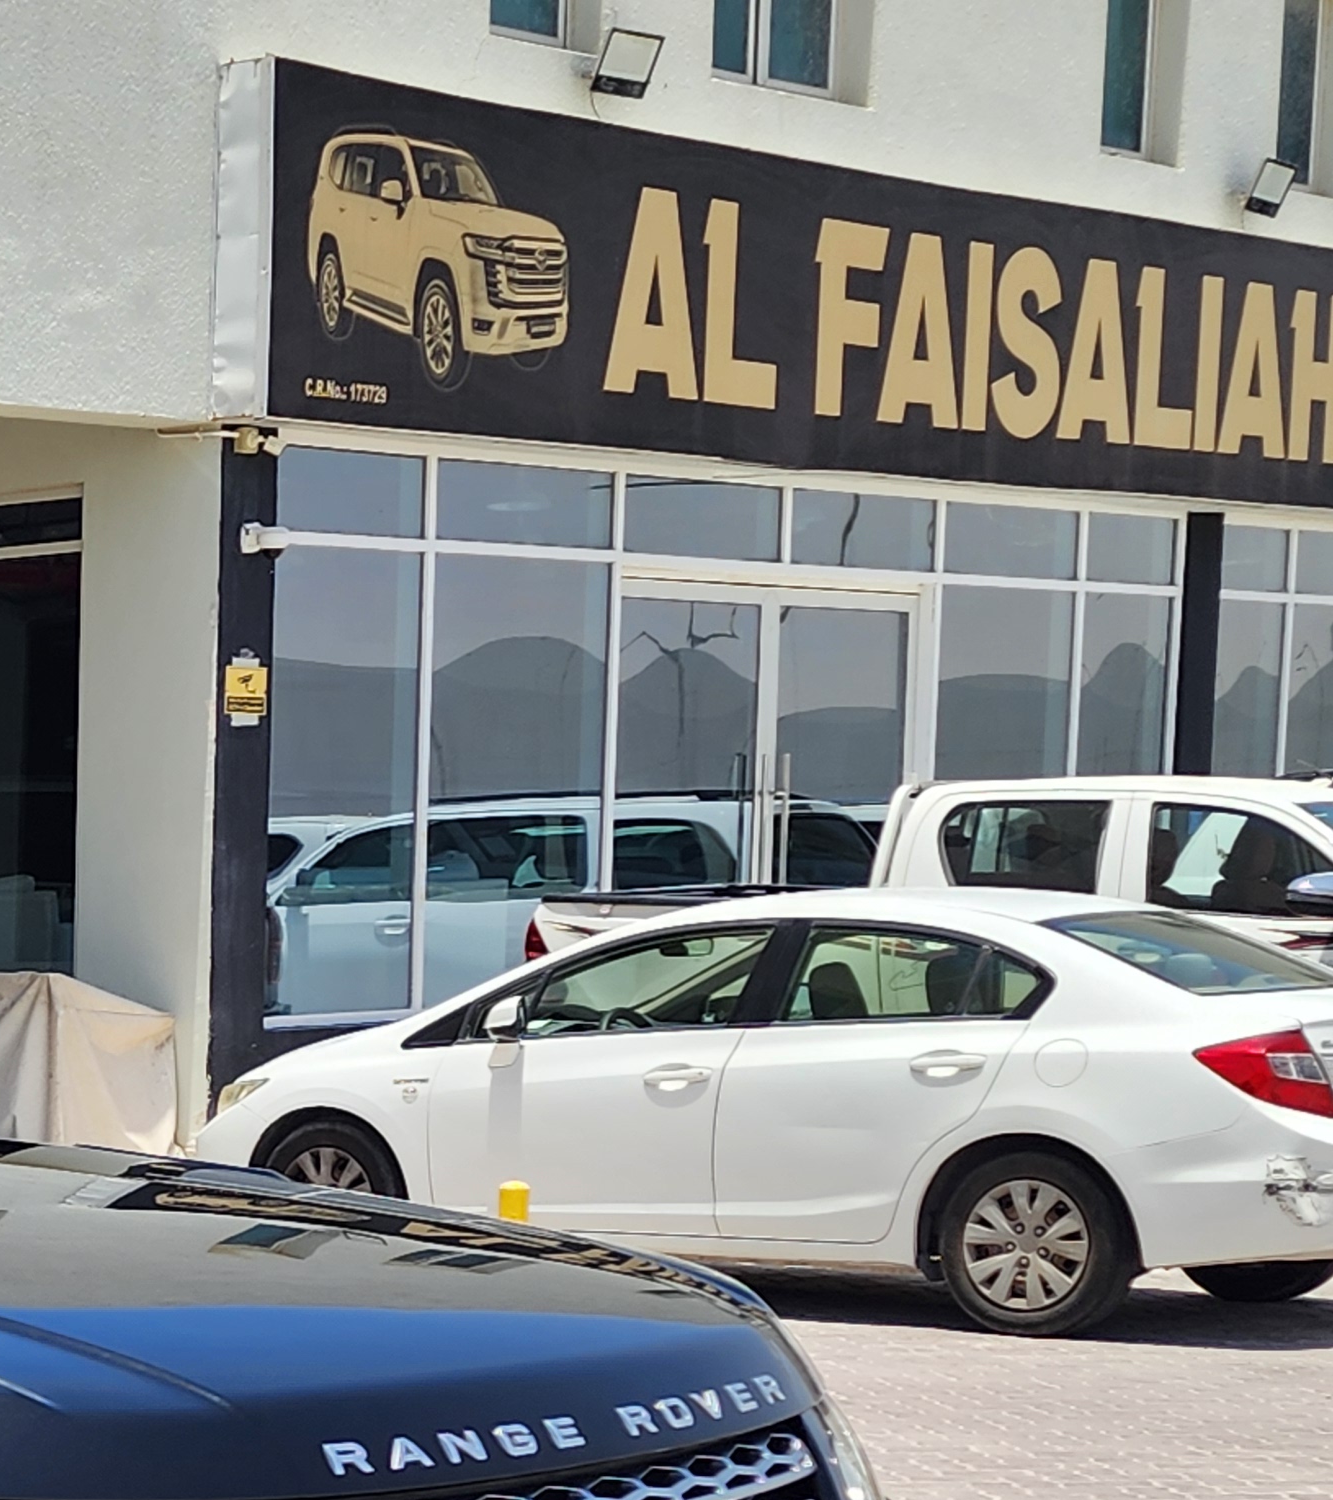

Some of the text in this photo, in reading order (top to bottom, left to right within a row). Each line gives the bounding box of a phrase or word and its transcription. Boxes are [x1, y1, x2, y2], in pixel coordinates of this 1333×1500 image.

[603, 186, 1333, 463] AL FAISALIAH
[321, 1373, 787, 1477] RANGE ROVER
